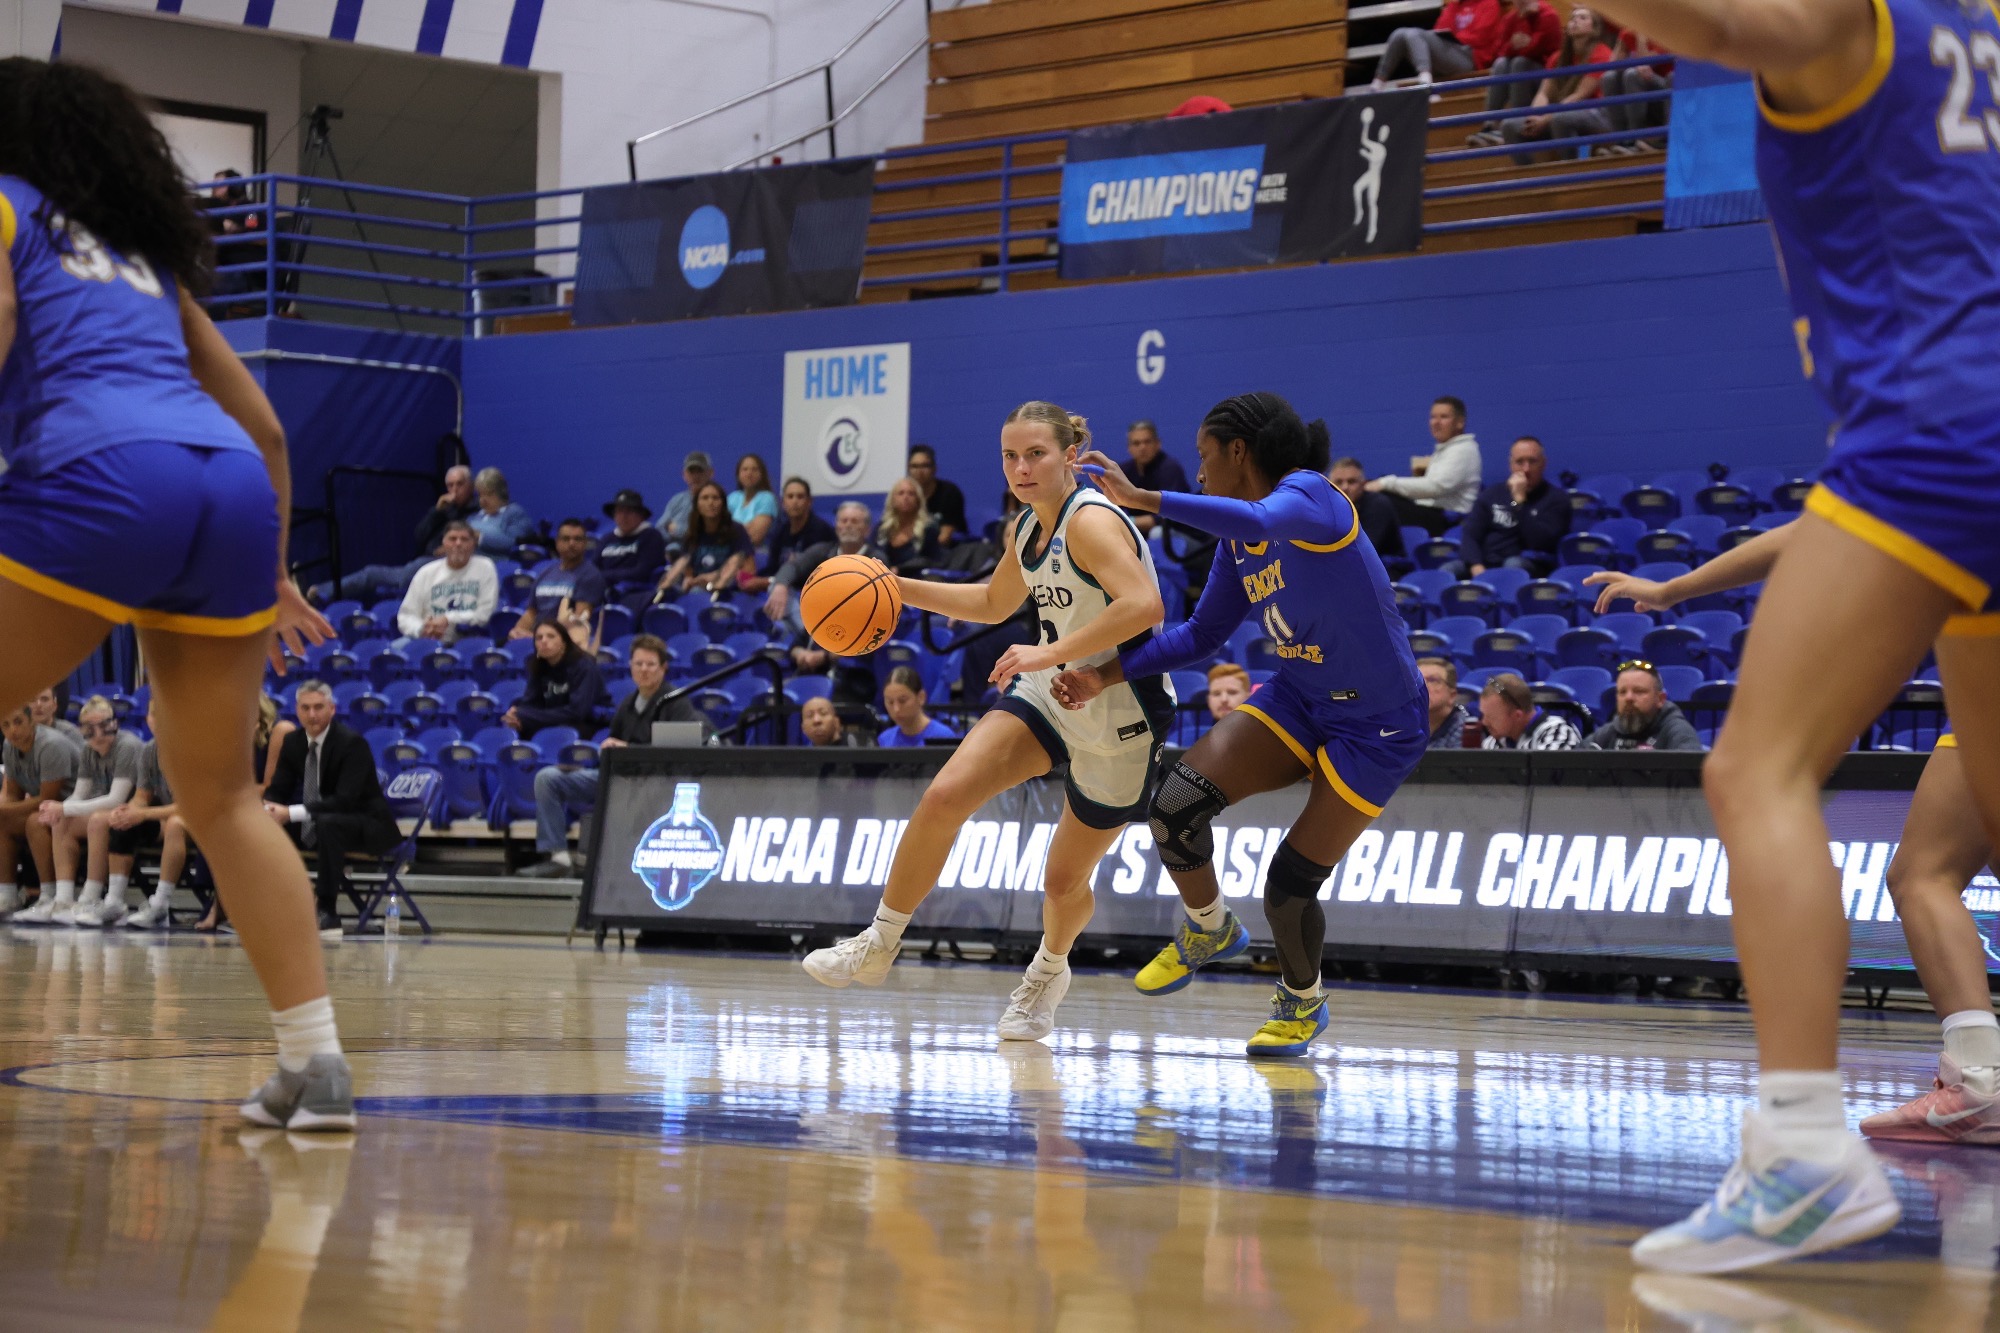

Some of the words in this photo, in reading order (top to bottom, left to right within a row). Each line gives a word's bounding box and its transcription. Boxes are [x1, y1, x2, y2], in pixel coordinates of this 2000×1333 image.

[1086, 168, 1258, 226] CHAMPIONS
[804, 353, 888, 399] HOME
[1137, 329, 1165, 384] G
[1243, 559, 1285, 603] EMY
[1263, 603, 1294, 645] 11
[1178, 763, 1204, 787] NEENCA
[635, 850, 721, 870] CHAMPIONSHIP
[721, 817, 839, 884] NCAA
[938, 820, 1153, 894] OM'S
[1156, 827, 1464, 906] ASKBALL
[1476, 832, 1901, 922] CHAMPIHI
